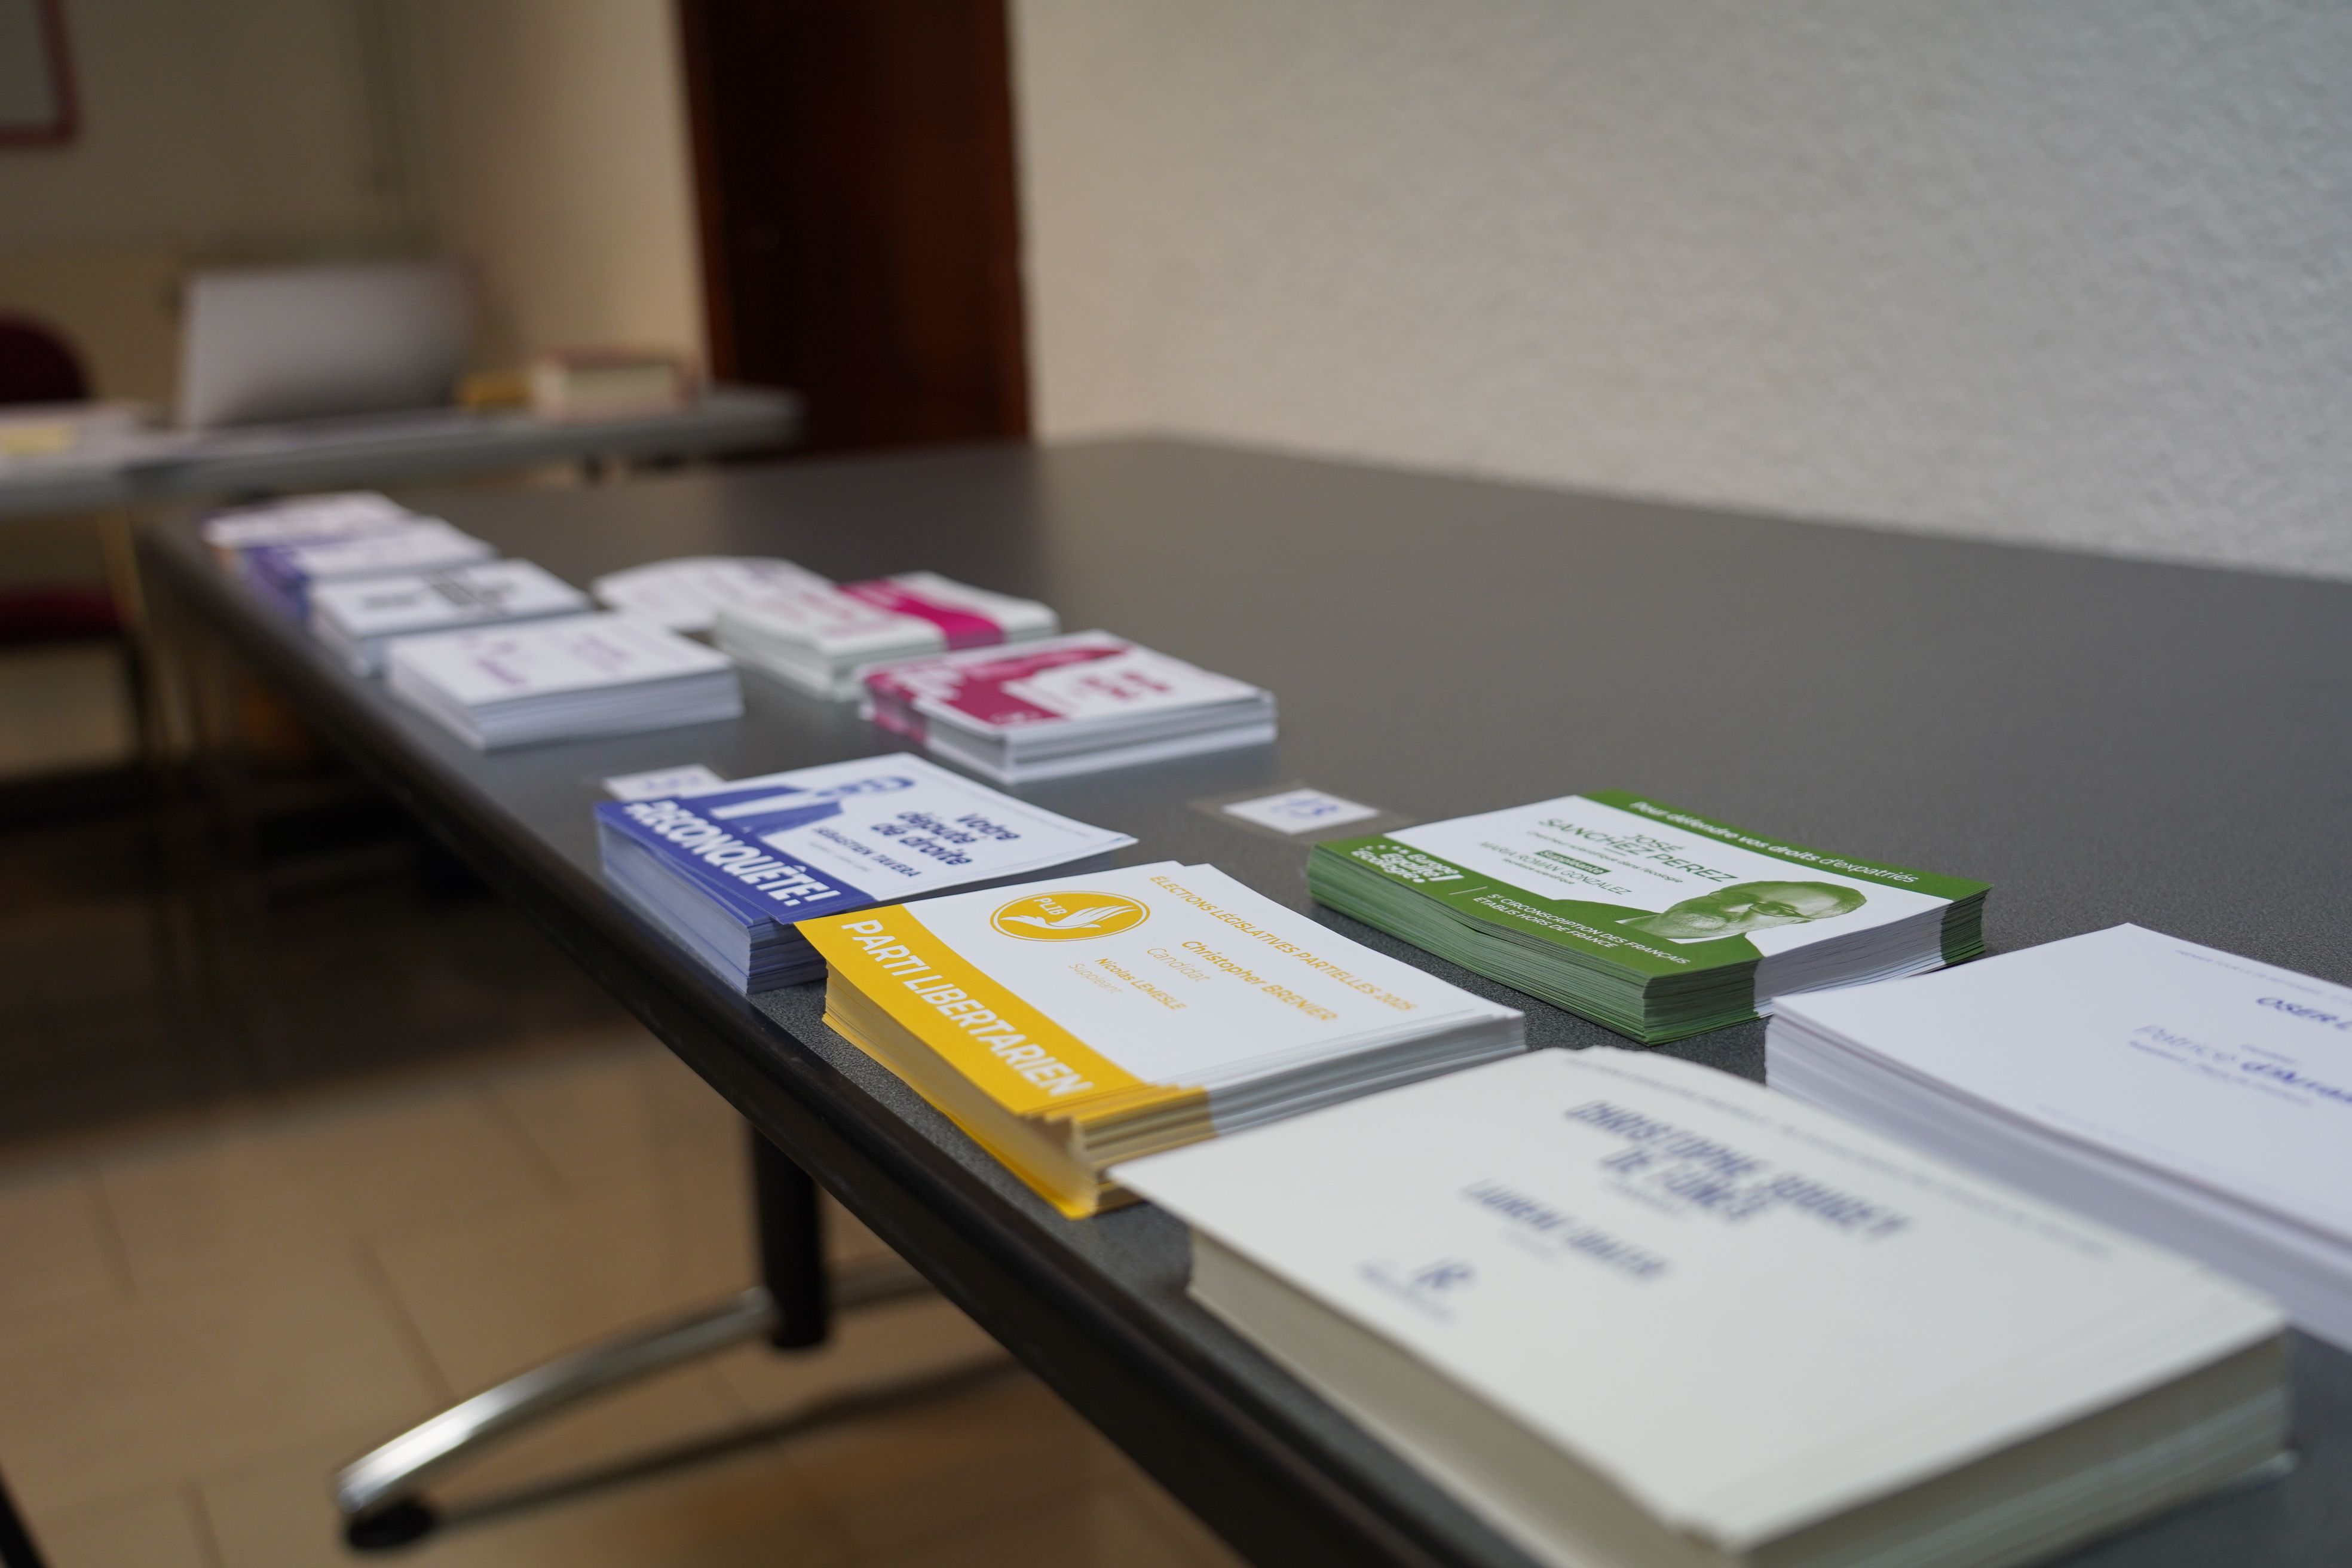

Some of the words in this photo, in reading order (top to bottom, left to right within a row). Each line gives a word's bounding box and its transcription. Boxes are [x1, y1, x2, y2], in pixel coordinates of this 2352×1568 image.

[871, 822, 914, 837] de
[899, 837, 972, 865] droite
[897, 813, 978, 844] député
[956, 814, 1020, 841] Votre
[1624, 834, 1684, 852] JOSÉ
[1666, 814, 1739, 838] défendre
[1738, 837, 1769, 847] vos
[1768, 846, 1820, 860] droits
[1819, 859, 1919, 882] d'expatriés
[873, 855, 921, 877] TAVERA
[1480, 842, 1517, 856] MARIA
[1517, 855, 1563, 871] ROMAN
[1561, 871, 1632, 895] GONZALEZ
[1539, 819, 1664, 855] SANCHEZ
[1647, 854, 1738, 882] PEREZ
[1033, 898, 1067, 915] PLIB
[1150, 876, 1218, 911] ÉLECTIONS
[1209, 910, 1300, 953] LÉGISLATIVES
[1293, 953, 1381, 994] PARTIELLES
[1374, 993, 1417, 1010] 2025
[1500, 899, 1603, 936] CIRCONSCRIPTION
[1599, 933, 1628, 943] DES
[1624, 942, 1690, 963] FRANÇAIS
[1516, 914, 1552, 925] HORS
[1566, 931, 1618, 947] FRANCE
[1068, 963, 1122, 994] Suppléant
[1095, 958, 1135, 981] Nicolas
[1131, 980, 1186, 1009] LEMESLE
[1147, 948, 1210, 982] Candidat
[1182, 942, 1267, 984] Christopher
[1261, 985, 1337, 1020] BRENIER
[841, 920, 930, 976] PARTI
[903, 975, 1094, 1096] LIBERTARIEN
